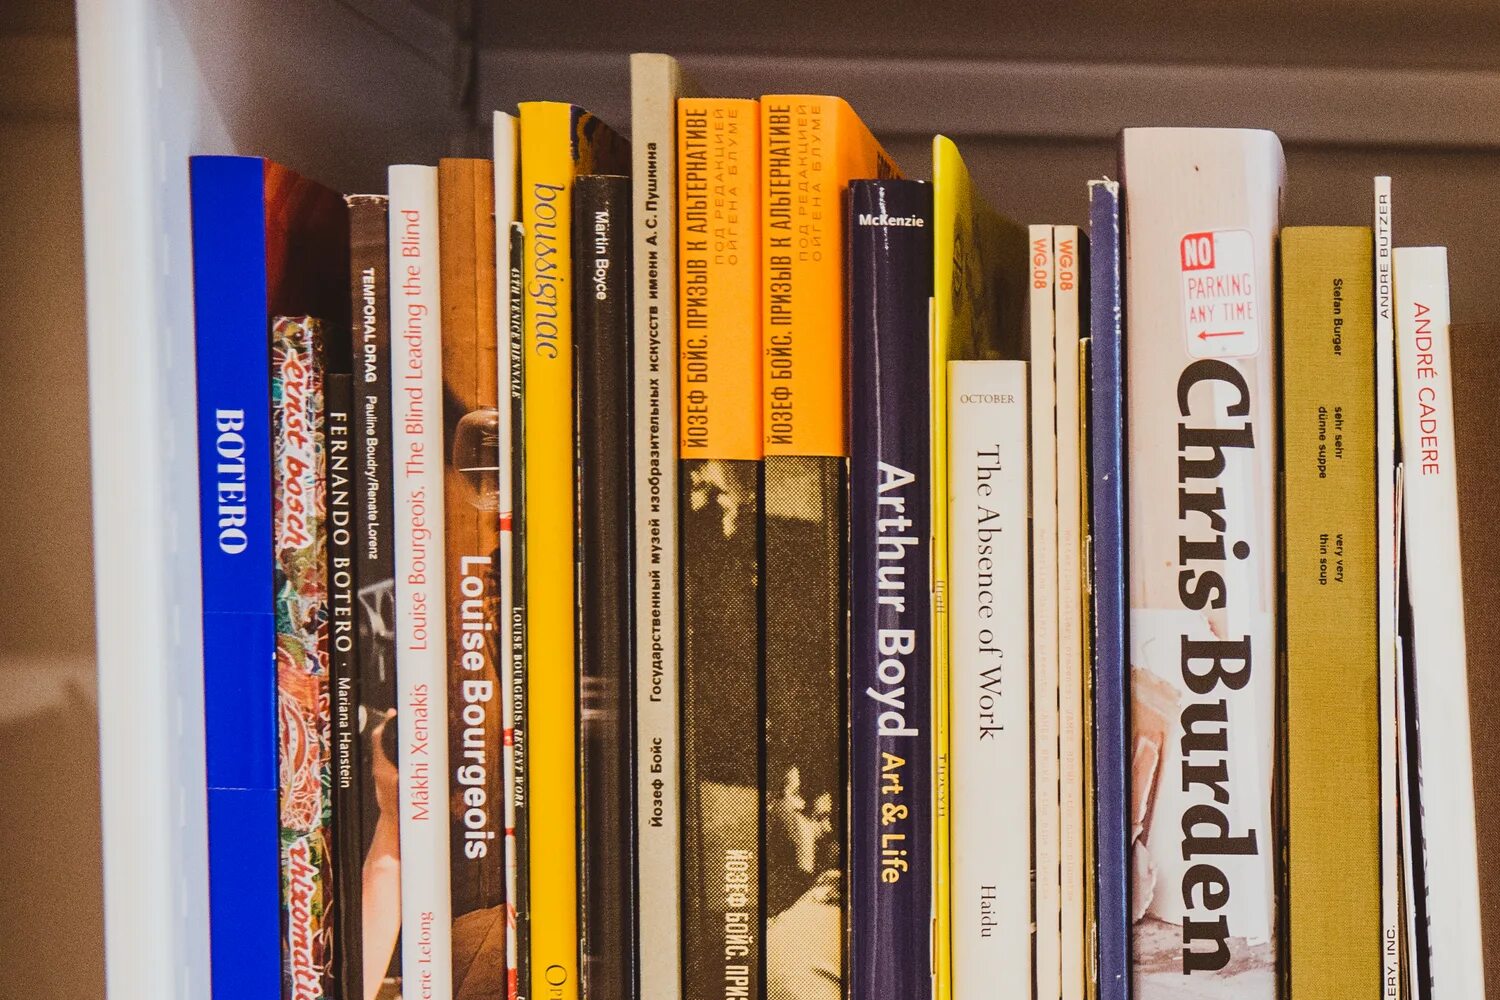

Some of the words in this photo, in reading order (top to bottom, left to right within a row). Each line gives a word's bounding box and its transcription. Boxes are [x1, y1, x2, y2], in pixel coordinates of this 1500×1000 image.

[858, 214, 924, 227] McKenzie
[529, 183, 565, 359] boussignac
[1033, 238, 1046, 289] WG.08
[1060, 240, 1072, 291] WG.08
[1187, 273, 1252, 296] PARKING
[362, 268, 375, 342] TEMPORAL
[1189, 307, 1215, 322] ANY
[1220, 302, 1255, 320] TIME
[1333, 278, 1344, 315] Stefan
[1332, 318, 1344, 356] Burger
[363, 344, 377, 382] DRAG
[365, 396, 377, 435] Pauline
[1318, 407, 1330, 441] dünne
[1334, 407, 1344, 431] sehr
[1417, 387, 1439, 476] CADERE
[977, 444, 1000, 497] The
[1317, 444, 1327, 479] suppe
[1334, 434, 1345, 459] sehr
[215, 408, 247, 554] BOTERO
[330, 412, 349, 546] FERNANDO
[364, 438, 380, 520] Boudry/Renate
[1175, 358, 1255, 612] Chris
[367, 523, 381, 559] Lorenz
[877, 460, 918, 613] Arthur
[977, 505, 1000, 619] Absence
[1319, 534, 1329, 554] thin
[1334, 534, 1344, 556] very
[1318, 557, 1328, 585] soup
[1334, 560, 1346, 583] very
[333, 557, 352, 653] BOTERO
[460, 555, 492, 670] Louise
[979, 629, 1003, 658] of
[338, 677, 351, 728] Mariana
[865, 629, 918, 736] Boyd
[978, 666, 1002, 741] Work
[339, 733, 352, 788] Hanstein
[457, 679, 495, 859] Bourgeois
[880, 752, 905, 794] Art
[881, 804, 907, 826] &
[1179, 635, 1258, 976] Burden
[881, 834, 908, 883] Life
[980, 885, 997, 938] Haidu
